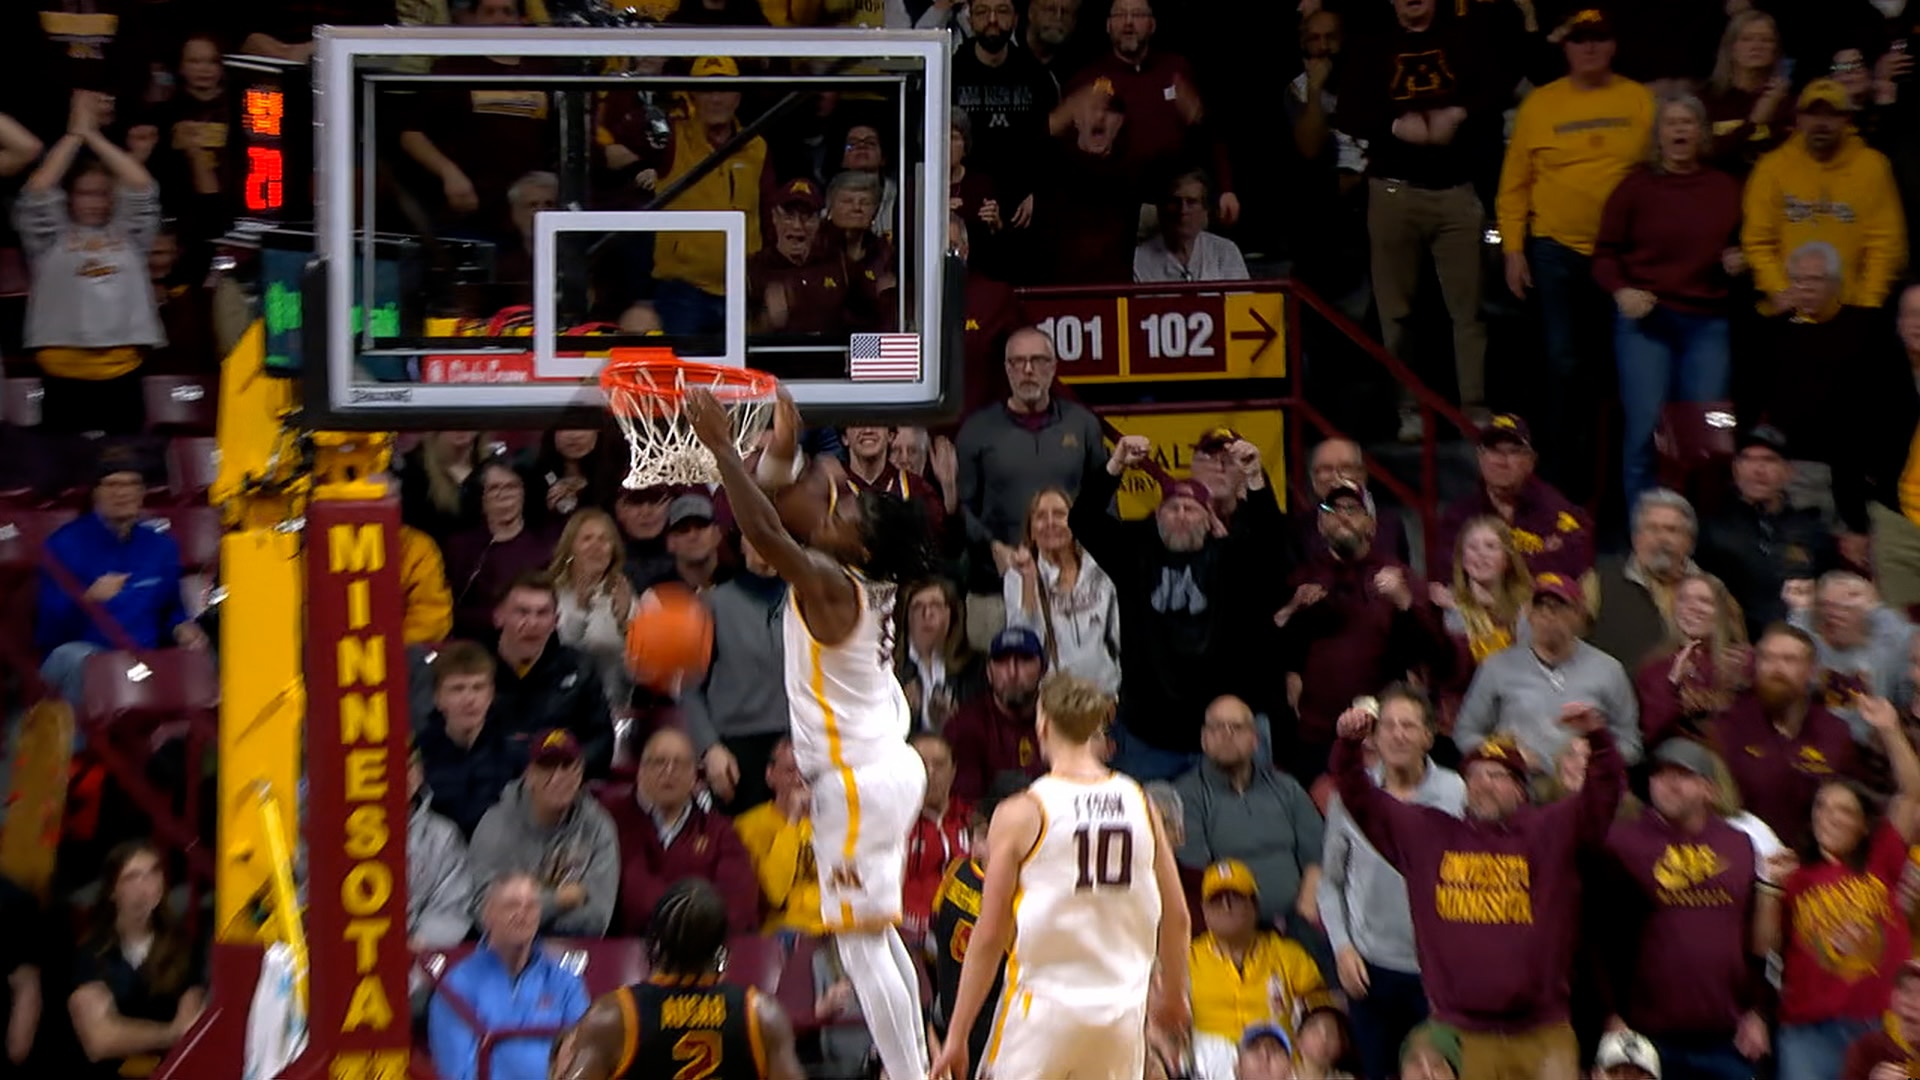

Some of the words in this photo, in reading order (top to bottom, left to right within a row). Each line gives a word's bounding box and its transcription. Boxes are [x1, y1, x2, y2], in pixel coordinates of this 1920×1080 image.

[1037, 315, 1102, 361] 101
[1141, 312, 1214, 358] 102
[327, 523, 394, 1033] MINNESOTA
[1072, 823, 1133, 891] 10
[671, 1031, 723, 1080] 2
